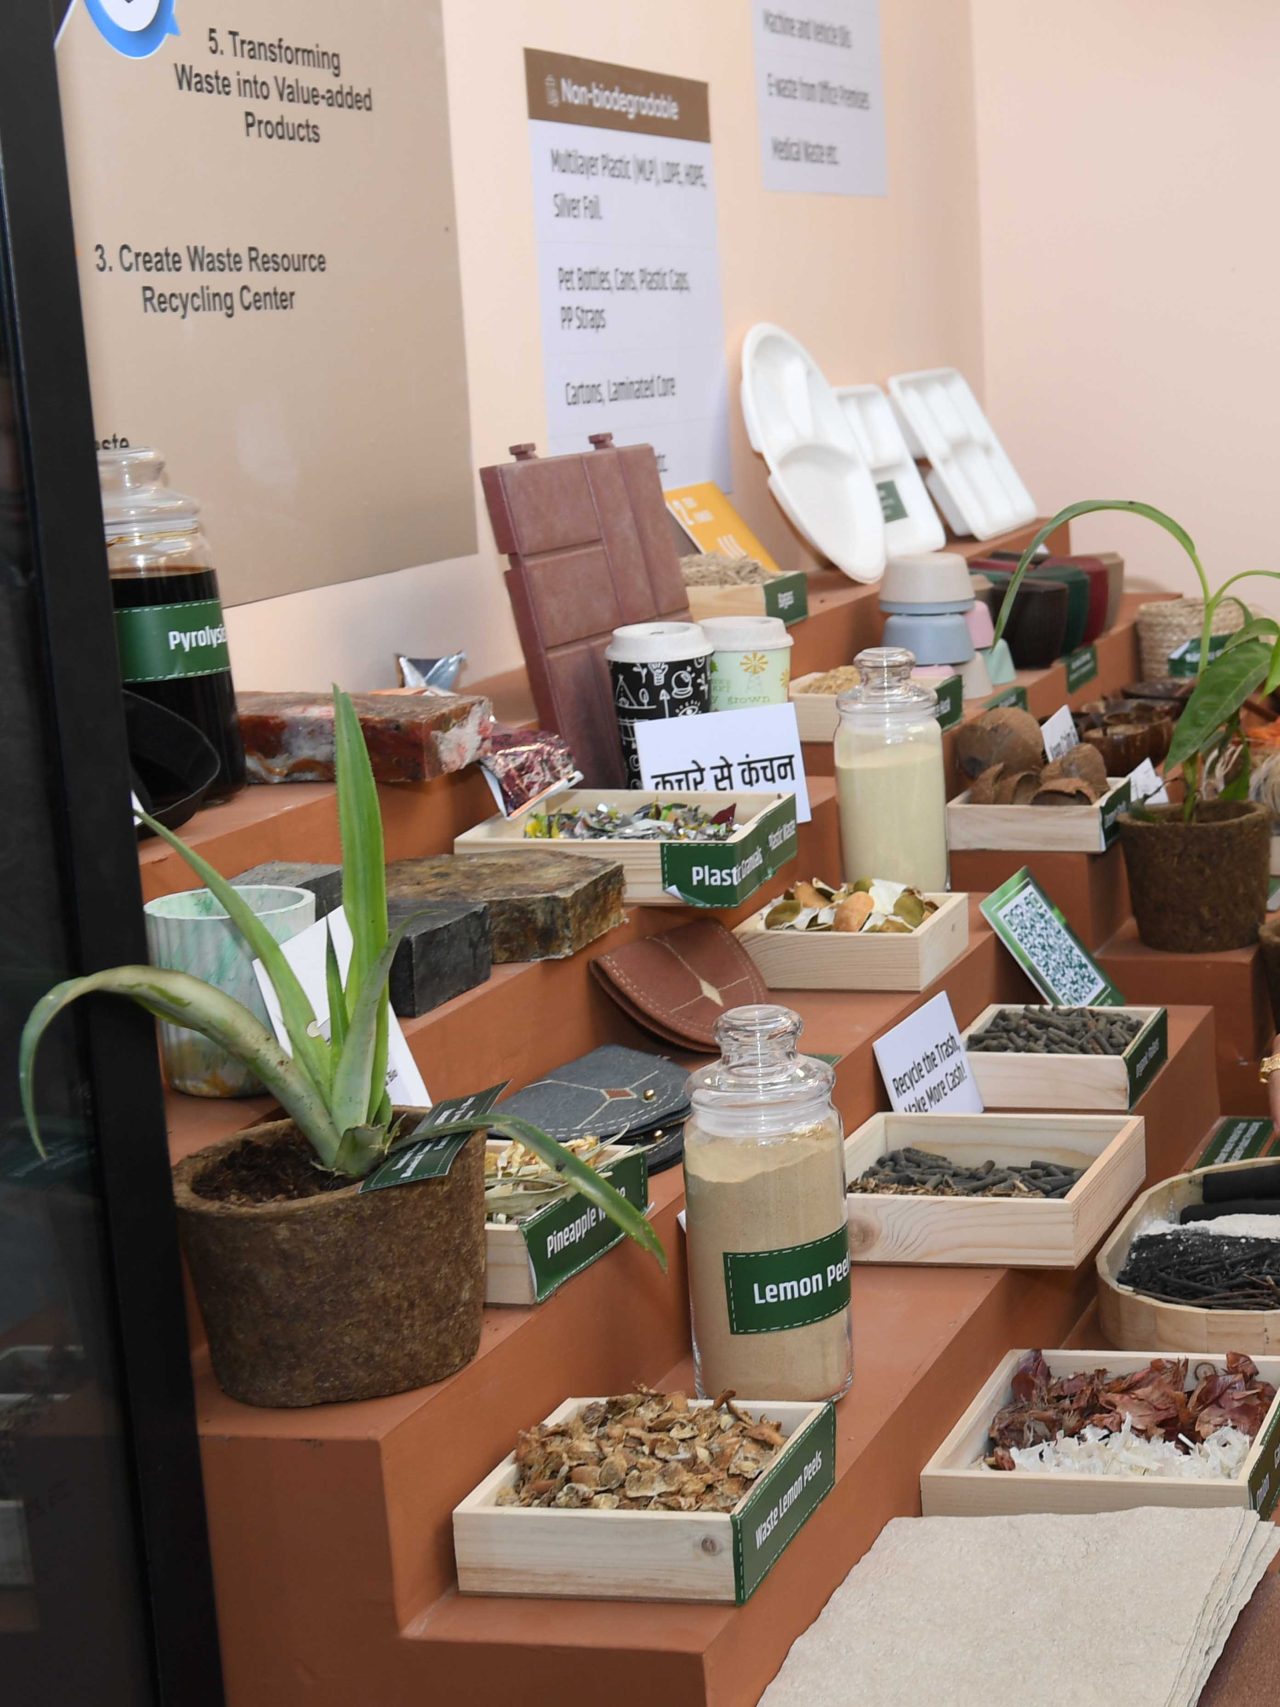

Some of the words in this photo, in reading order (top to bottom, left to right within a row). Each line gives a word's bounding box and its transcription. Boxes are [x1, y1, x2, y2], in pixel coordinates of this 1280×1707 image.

[208, 28, 224, 55] 5.
[228, 31, 341, 77] Transforming
[174, 63, 232, 96] Waste
[236, 71, 271, 101] into
[274, 76, 373, 112] Value-added
[560, 77, 679, 120] Non-biodegradable
[245, 111, 321, 144] Products
[550, 148, 599, 180] Multilayer
[601, 153, 632, 179] Plastic
[553, 192, 581, 218] Silver
[95, 244, 113, 272] 3.
[118, 244, 182, 273] Create
[186, 245, 243, 273] Waste
[248, 246, 326, 273] Resource
[558, 267, 575, 291] Pet
[577, 267, 613, 293] Bottles,
[639, 268, 669, 291] Plastic
[141, 285, 235, 319] Recycling
[239, 284, 295, 312] Center
[560, 306, 573, 329] PP
[575, 306, 606, 333] Straps
[565, 382, 605, 406] Cartons,
[608, 376, 655, 402] Laminated
[710, 756, 733, 791] से
[737, 754, 795, 787] कंचन
[692, 864, 741, 887] Plastic
[892, 1061, 925, 1098] Recycle
[922, 1052, 938, 1074] the
[935, 1032, 961, 1063] Trash,
[925, 1080, 948, 1109] More
[945, 1060, 968, 1092] Cash!
[547, 1207, 597, 1259] Pineapple
[753, 1273, 823, 1305] Lemon
[755, 1508, 778, 1551] Waste
[778, 1473, 803, 1520] Lemon
[803, 1450, 822, 1488] Peels
